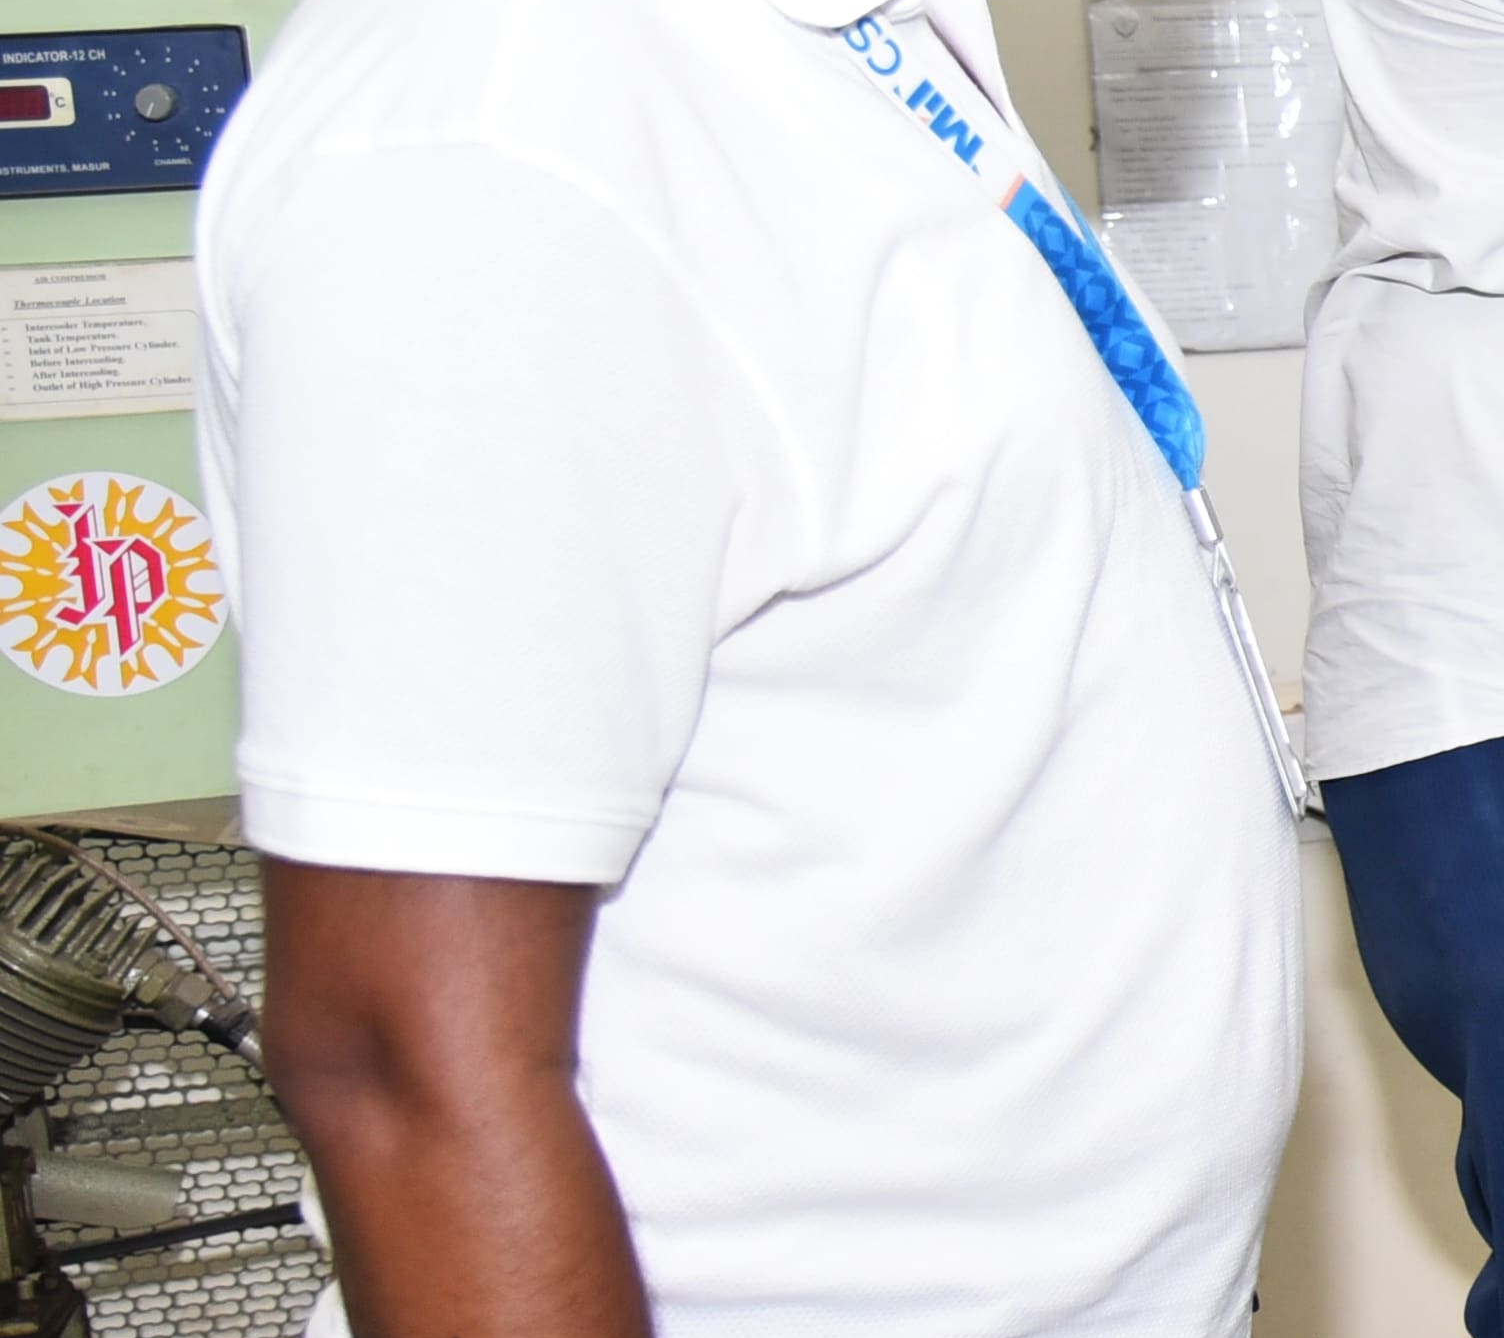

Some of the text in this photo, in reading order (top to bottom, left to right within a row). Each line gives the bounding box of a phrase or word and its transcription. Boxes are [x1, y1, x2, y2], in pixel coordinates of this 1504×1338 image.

[89, 49, 106, 60] CH
[72, 162, 111, 172] MASUR
[85, 295, 127, 306] Location
